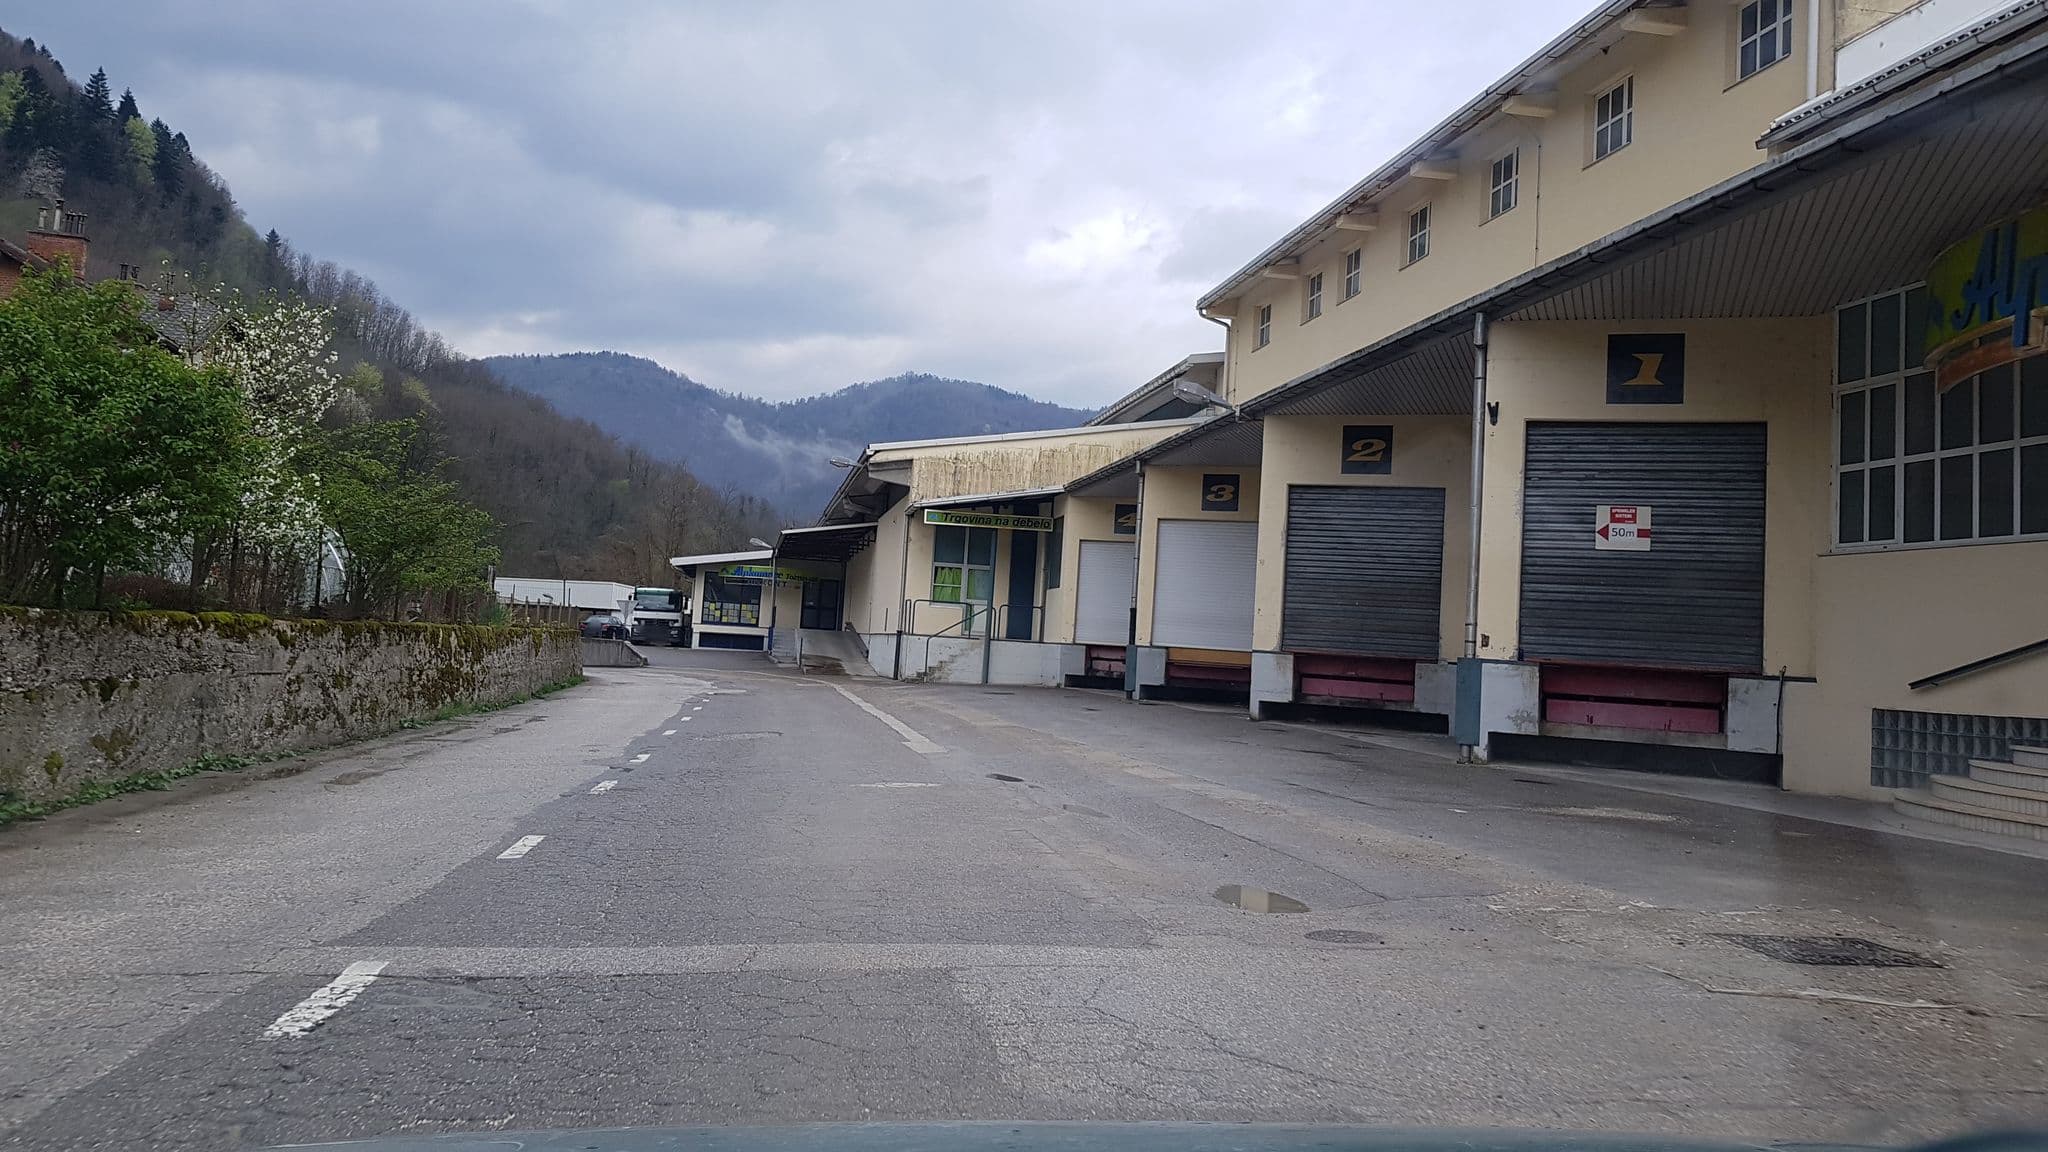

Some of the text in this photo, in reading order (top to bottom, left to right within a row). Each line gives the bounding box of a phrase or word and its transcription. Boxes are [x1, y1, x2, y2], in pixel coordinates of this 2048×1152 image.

[1620, 352, 1665, 386] 1
[1345, 438, 1387, 462] 2
[1205, 484, 1236, 502] 3
[942, 512, 1051, 529] Trgovina na debelo
[1611, 527, 1635, 537] 50m
